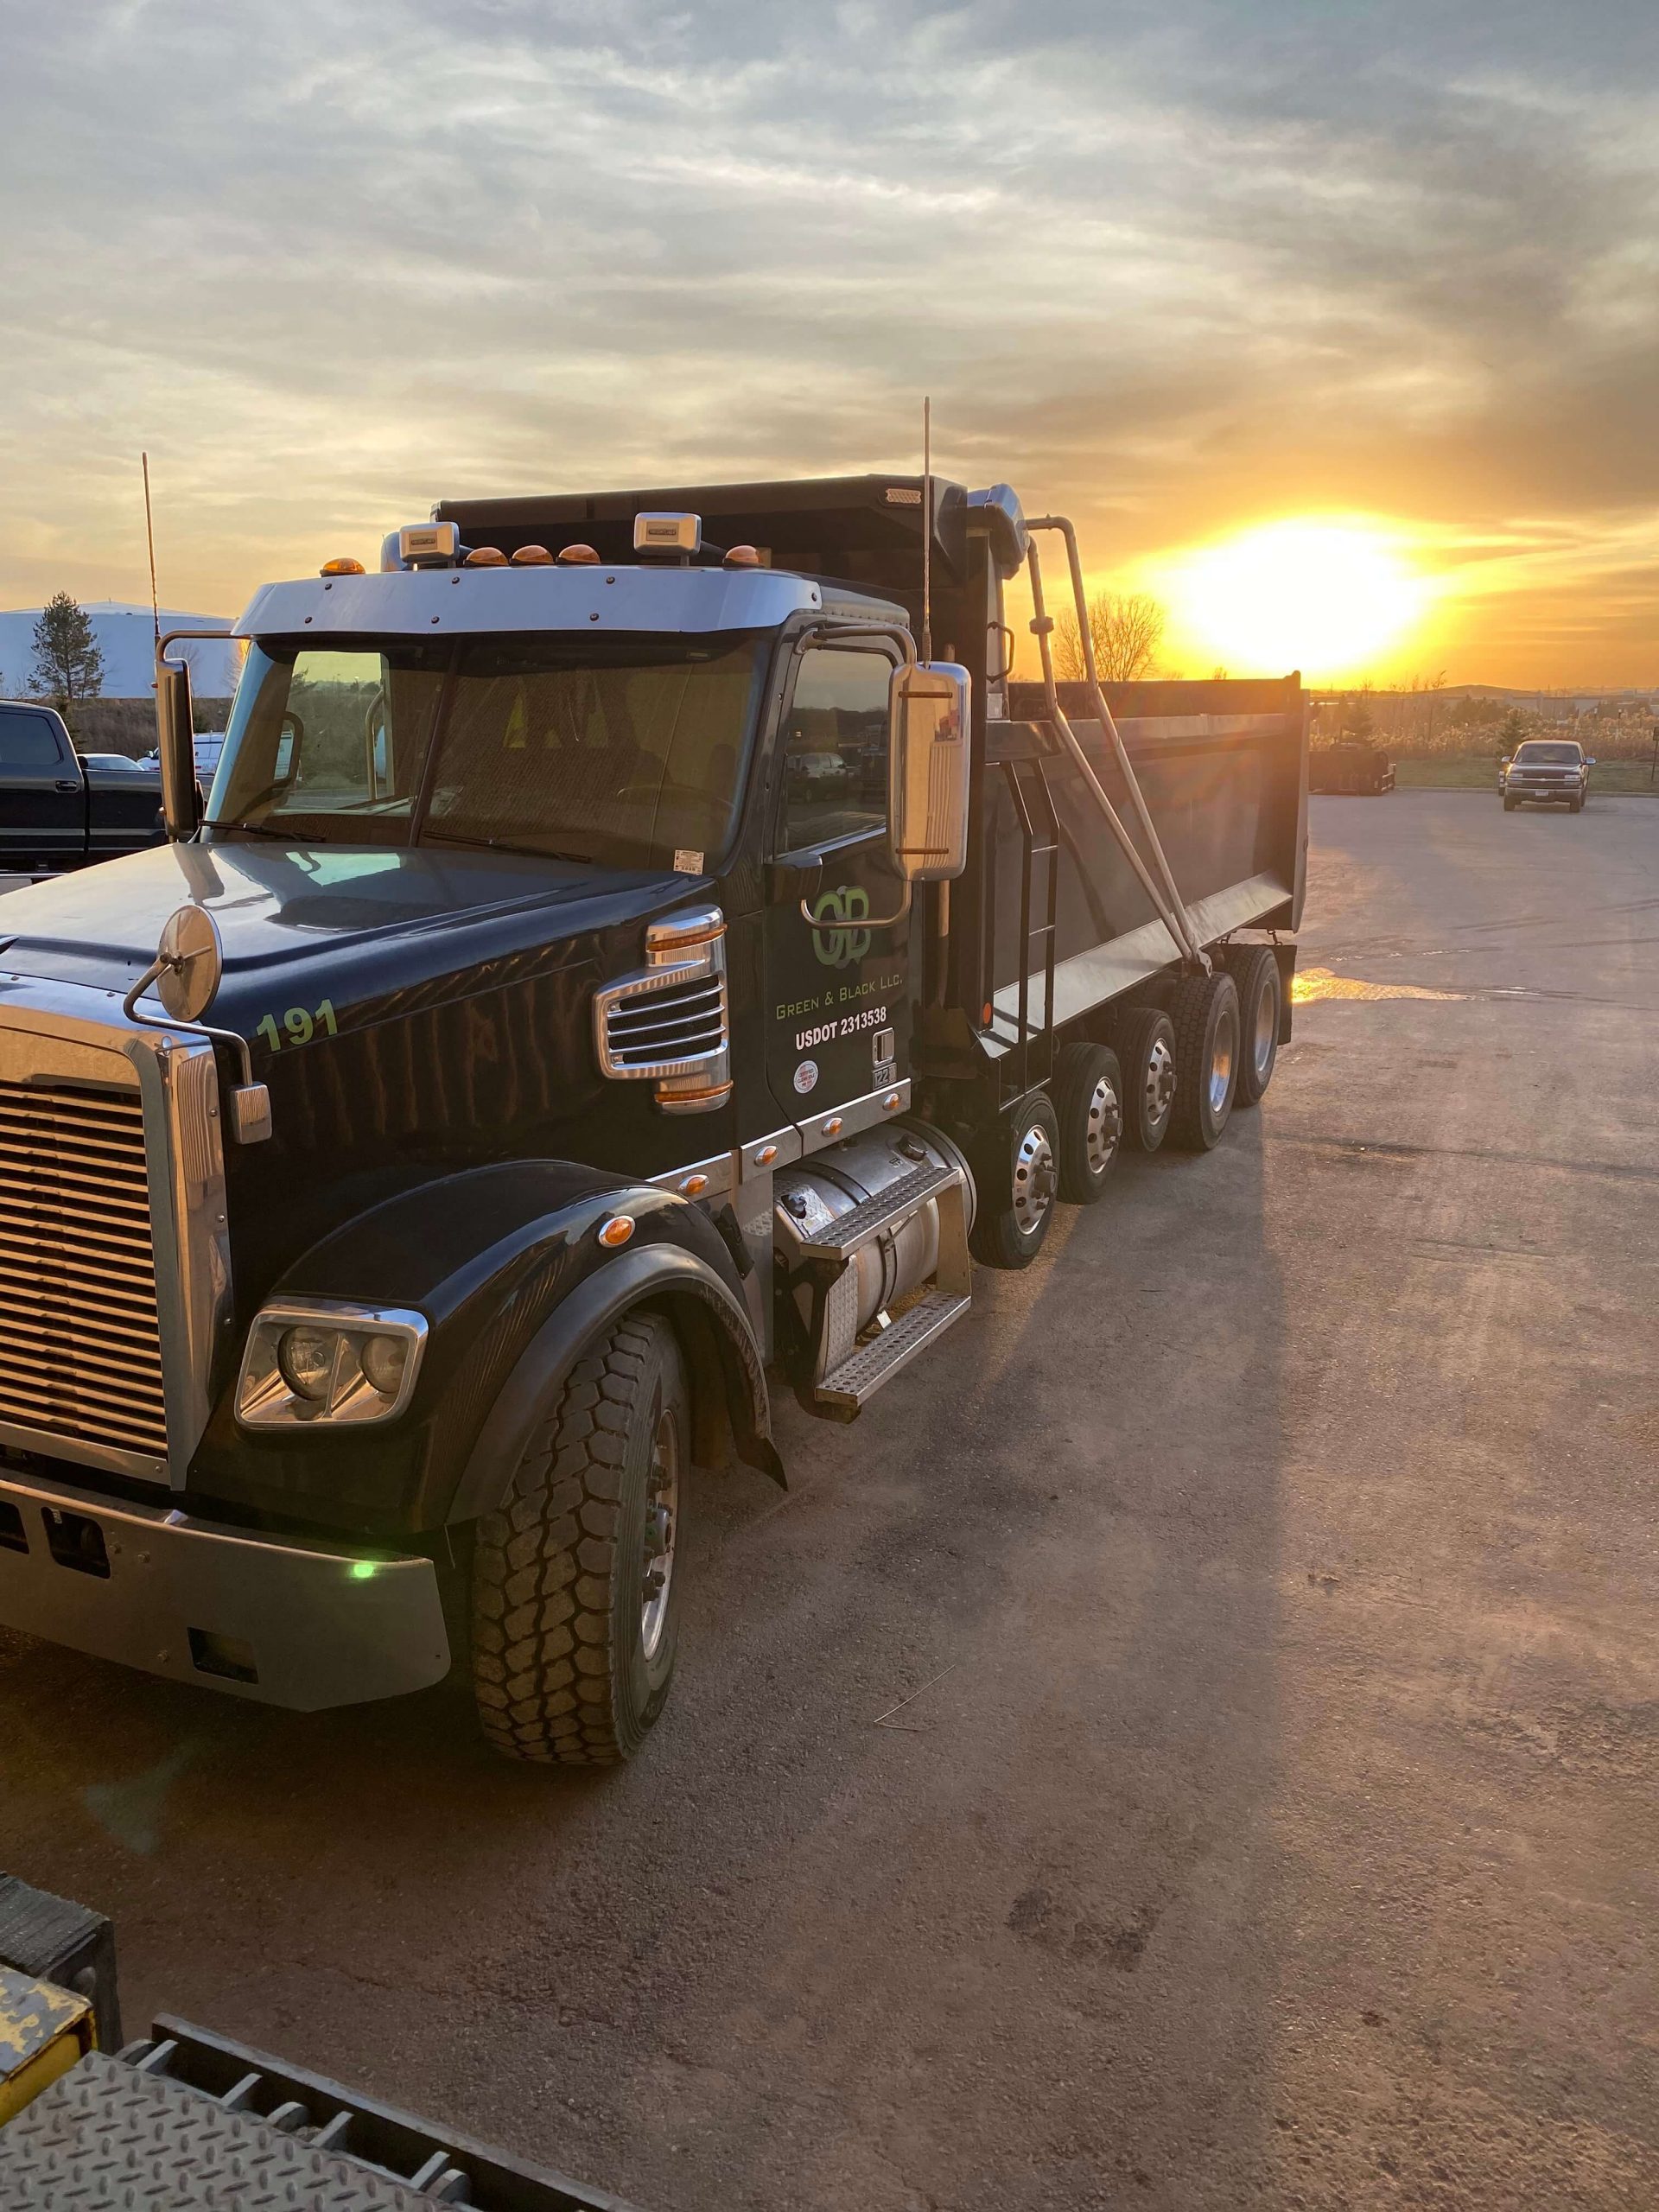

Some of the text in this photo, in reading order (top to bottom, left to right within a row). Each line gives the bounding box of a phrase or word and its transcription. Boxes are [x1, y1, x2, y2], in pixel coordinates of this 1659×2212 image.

[824, 991, 834, 1006] &
[256, 998, 338, 1052] 191
[795, 1006, 887, 1051] USDOT 2313538
